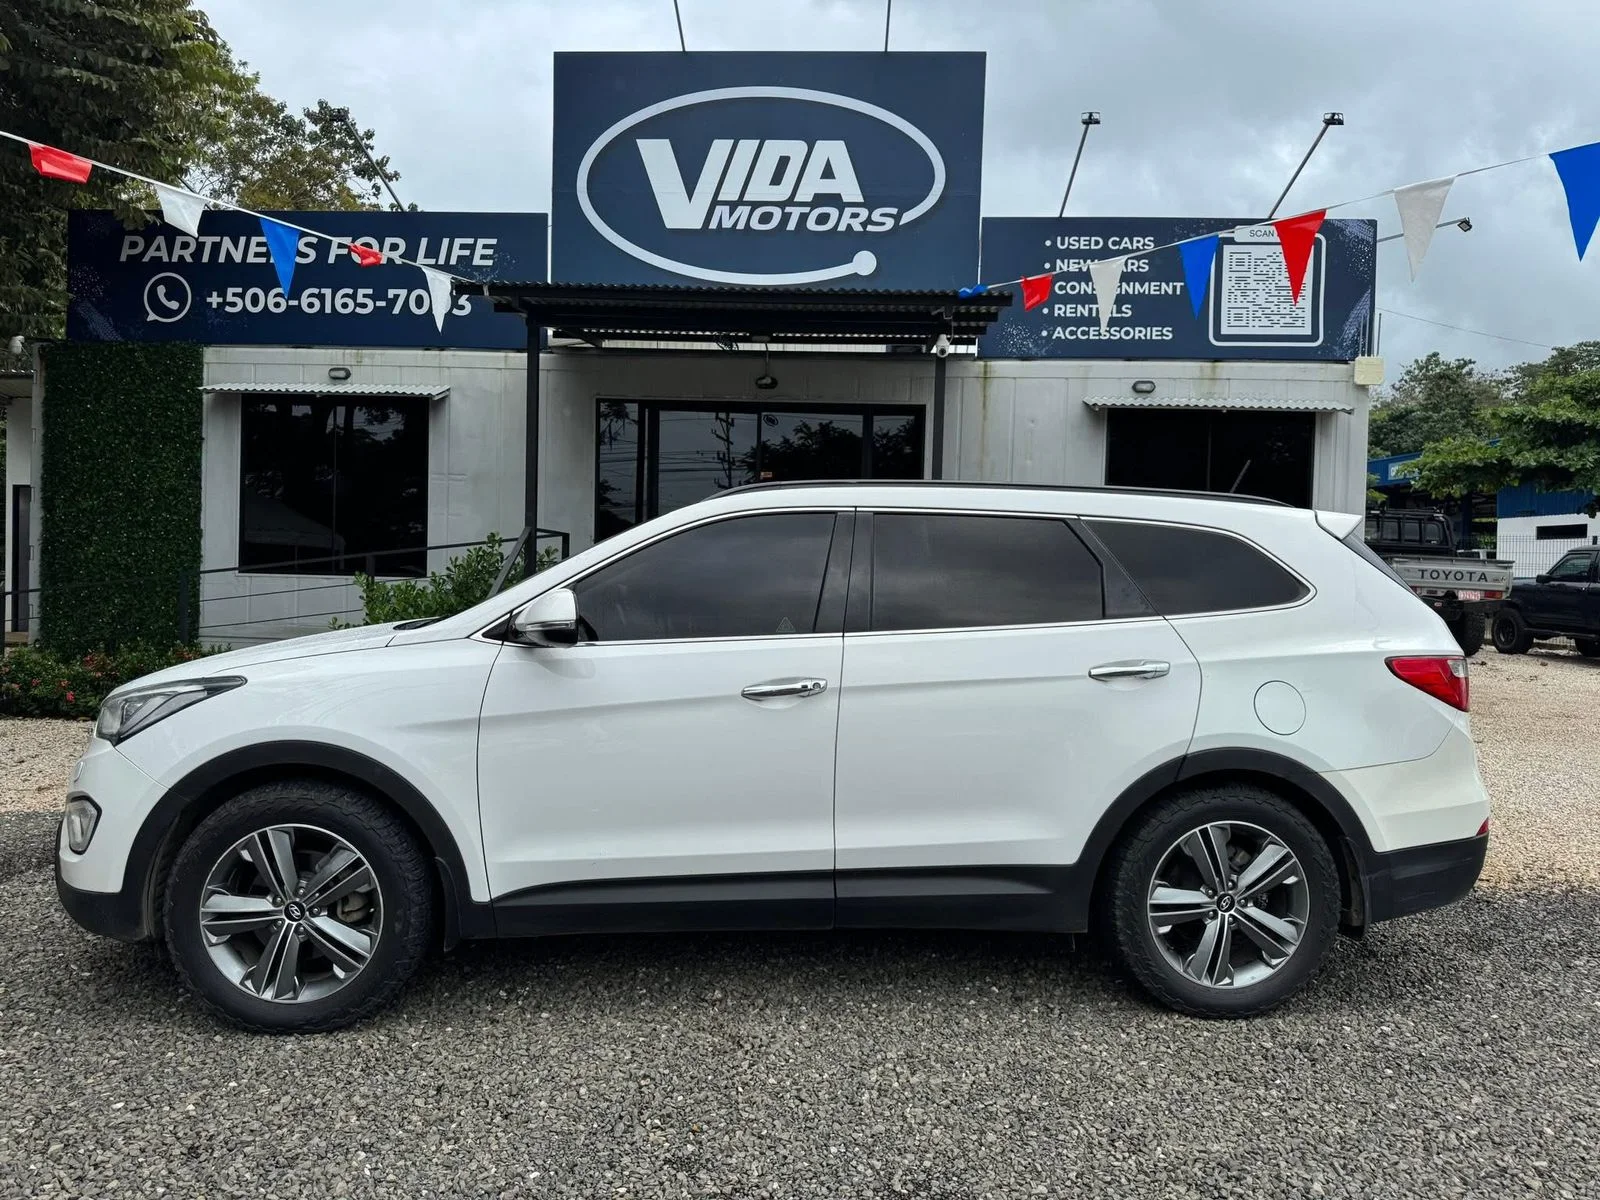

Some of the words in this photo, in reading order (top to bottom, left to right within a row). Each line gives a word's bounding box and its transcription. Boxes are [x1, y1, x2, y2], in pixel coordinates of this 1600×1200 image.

[636, 138, 865, 229] VIDA
[708, 205, 898, 232] MOTORS
[1249, 229, 1275, 238] SCAN
[1056, 236, 1104, 250] USED
[1108, 236, 1155, 250] CARS
[119, 235, 318, 264] PARTNES
[416, 237, 498, 266] LIFE
[206, 287, 472, 316] +506-6165-703
[1054, 304, 1133, 318] RENTLS
[1052, 326, 1173, 340] ACCESSORIES
[1418, 569, 1488, 583] TOYOTA
